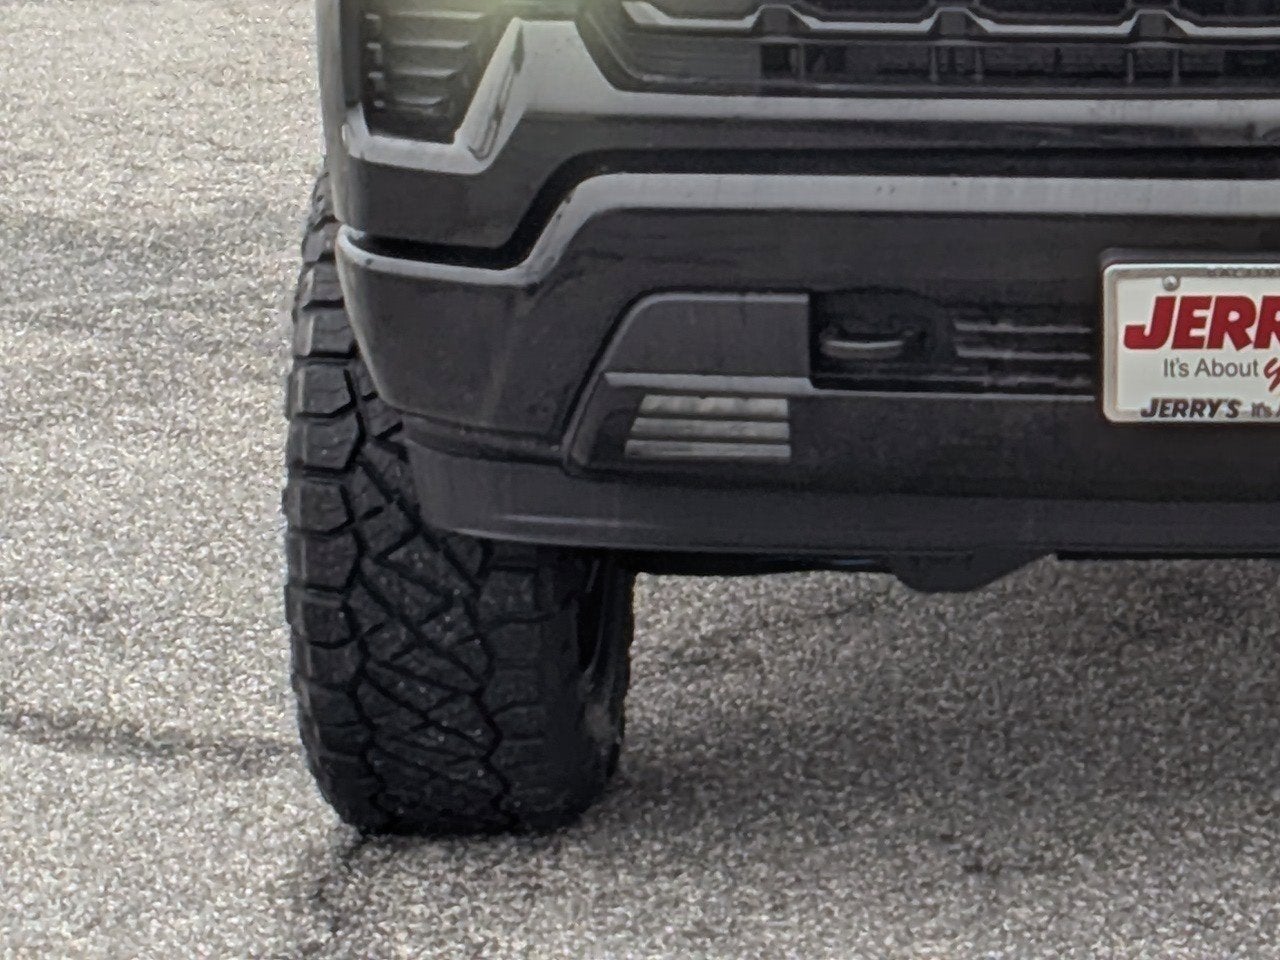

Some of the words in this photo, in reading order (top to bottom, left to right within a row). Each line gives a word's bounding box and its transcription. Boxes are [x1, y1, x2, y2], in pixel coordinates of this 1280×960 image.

[1163, 358, 1189, 377] It's
[1195, 358, 1259, 377] About
[1140, 397, 1243, 418] JERRY'S
[1251, 402, 1274, 417] It's
